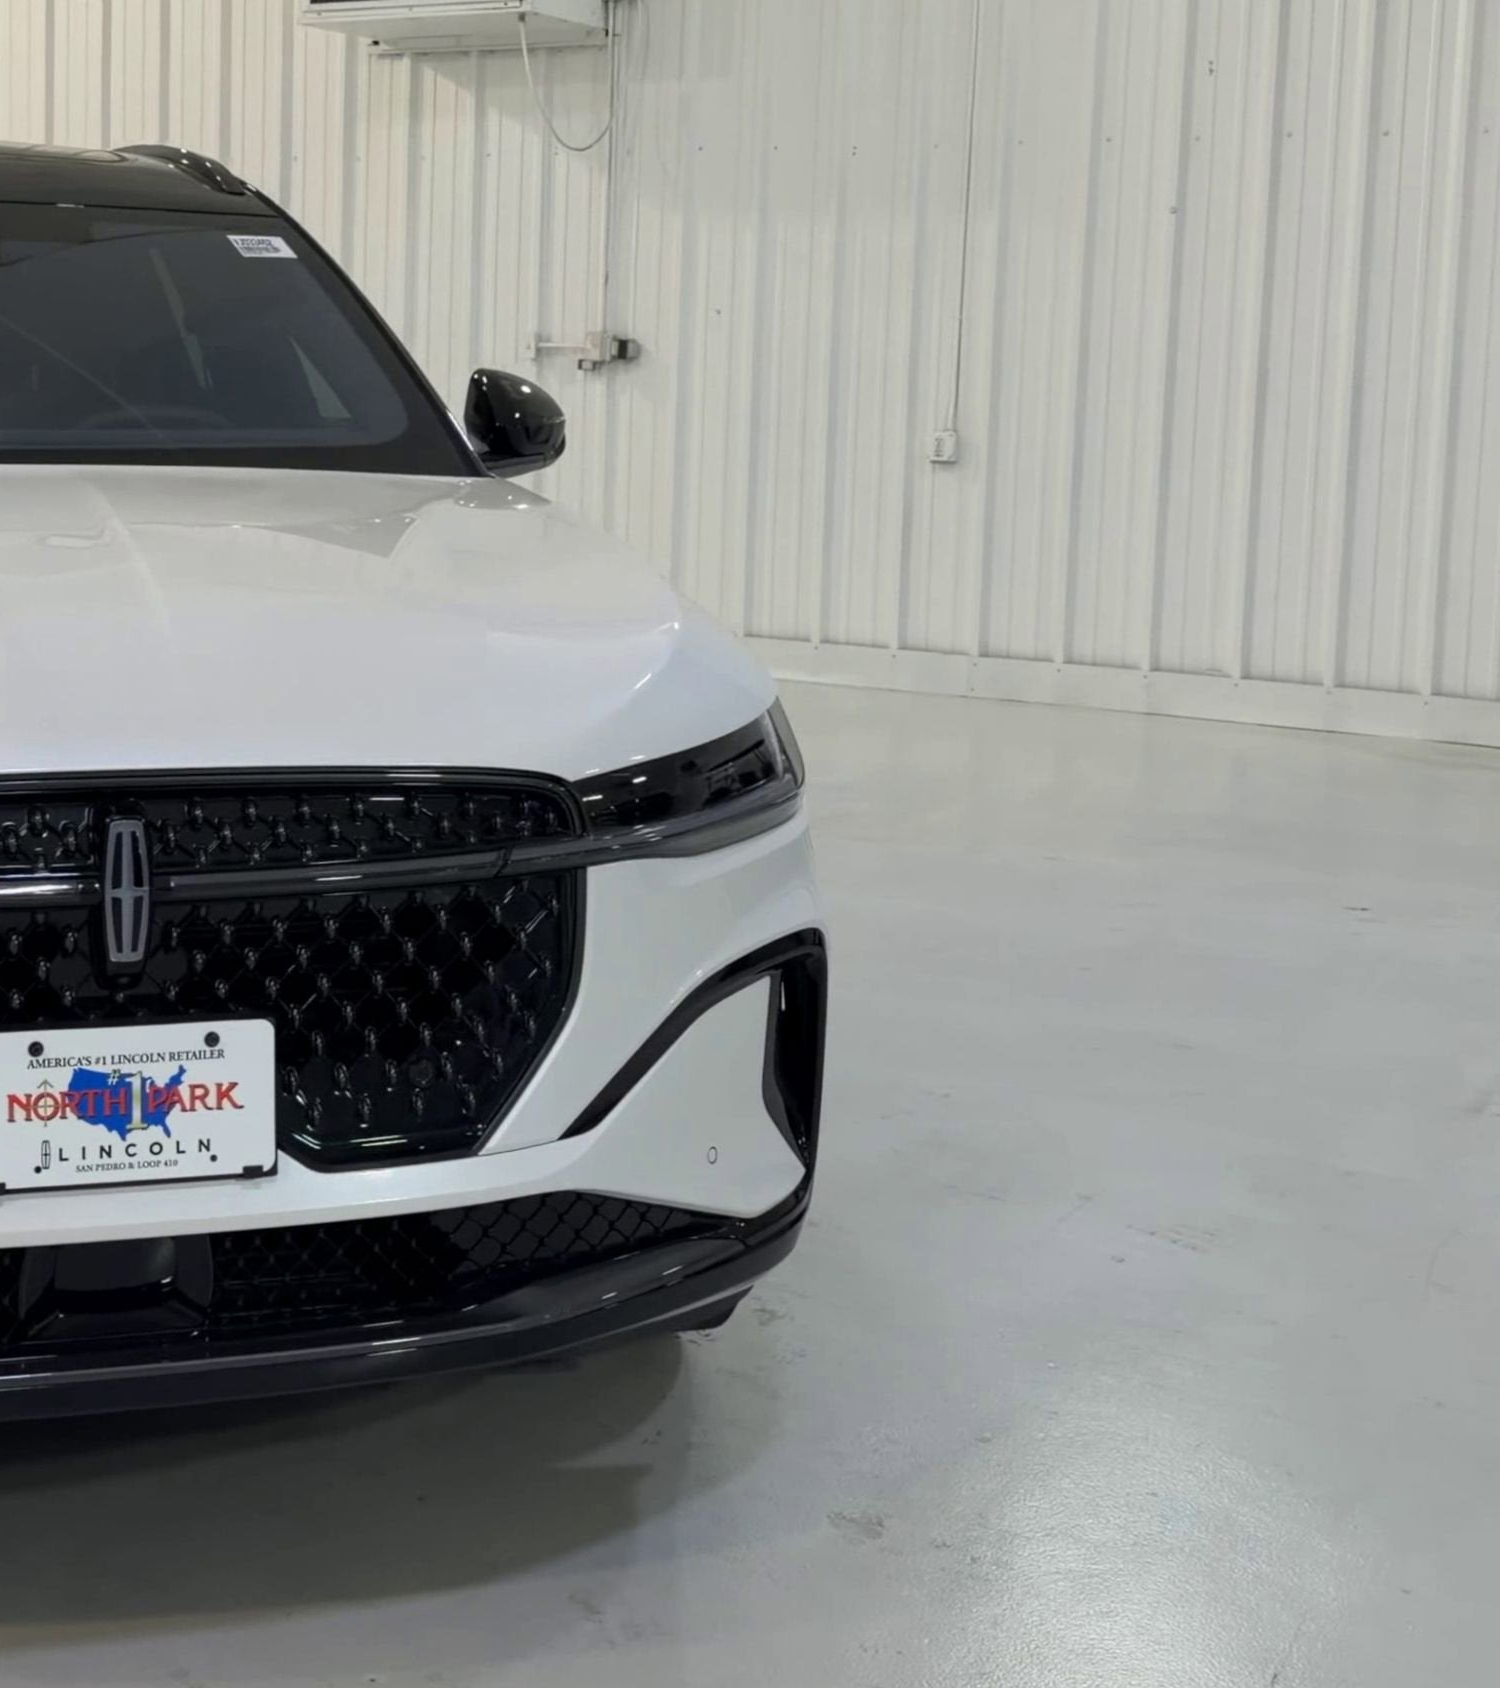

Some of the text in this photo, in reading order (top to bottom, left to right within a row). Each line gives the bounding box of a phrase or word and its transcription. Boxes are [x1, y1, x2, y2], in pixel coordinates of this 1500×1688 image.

[27, 1049, 225, 1070] AMERICA'S #1 LINCOLN RETAILER
[6, 1082, 244, 1123] NORTH PARK
[59, 1138, 211, 1161] LINCOLN
[76, 1163, 93, 1173] SAN
[95, 1162, 126, 1172] PEDRO
[137, 1159, 161, 1169] LOOP
[164, 1158, 179, 1168] 410
